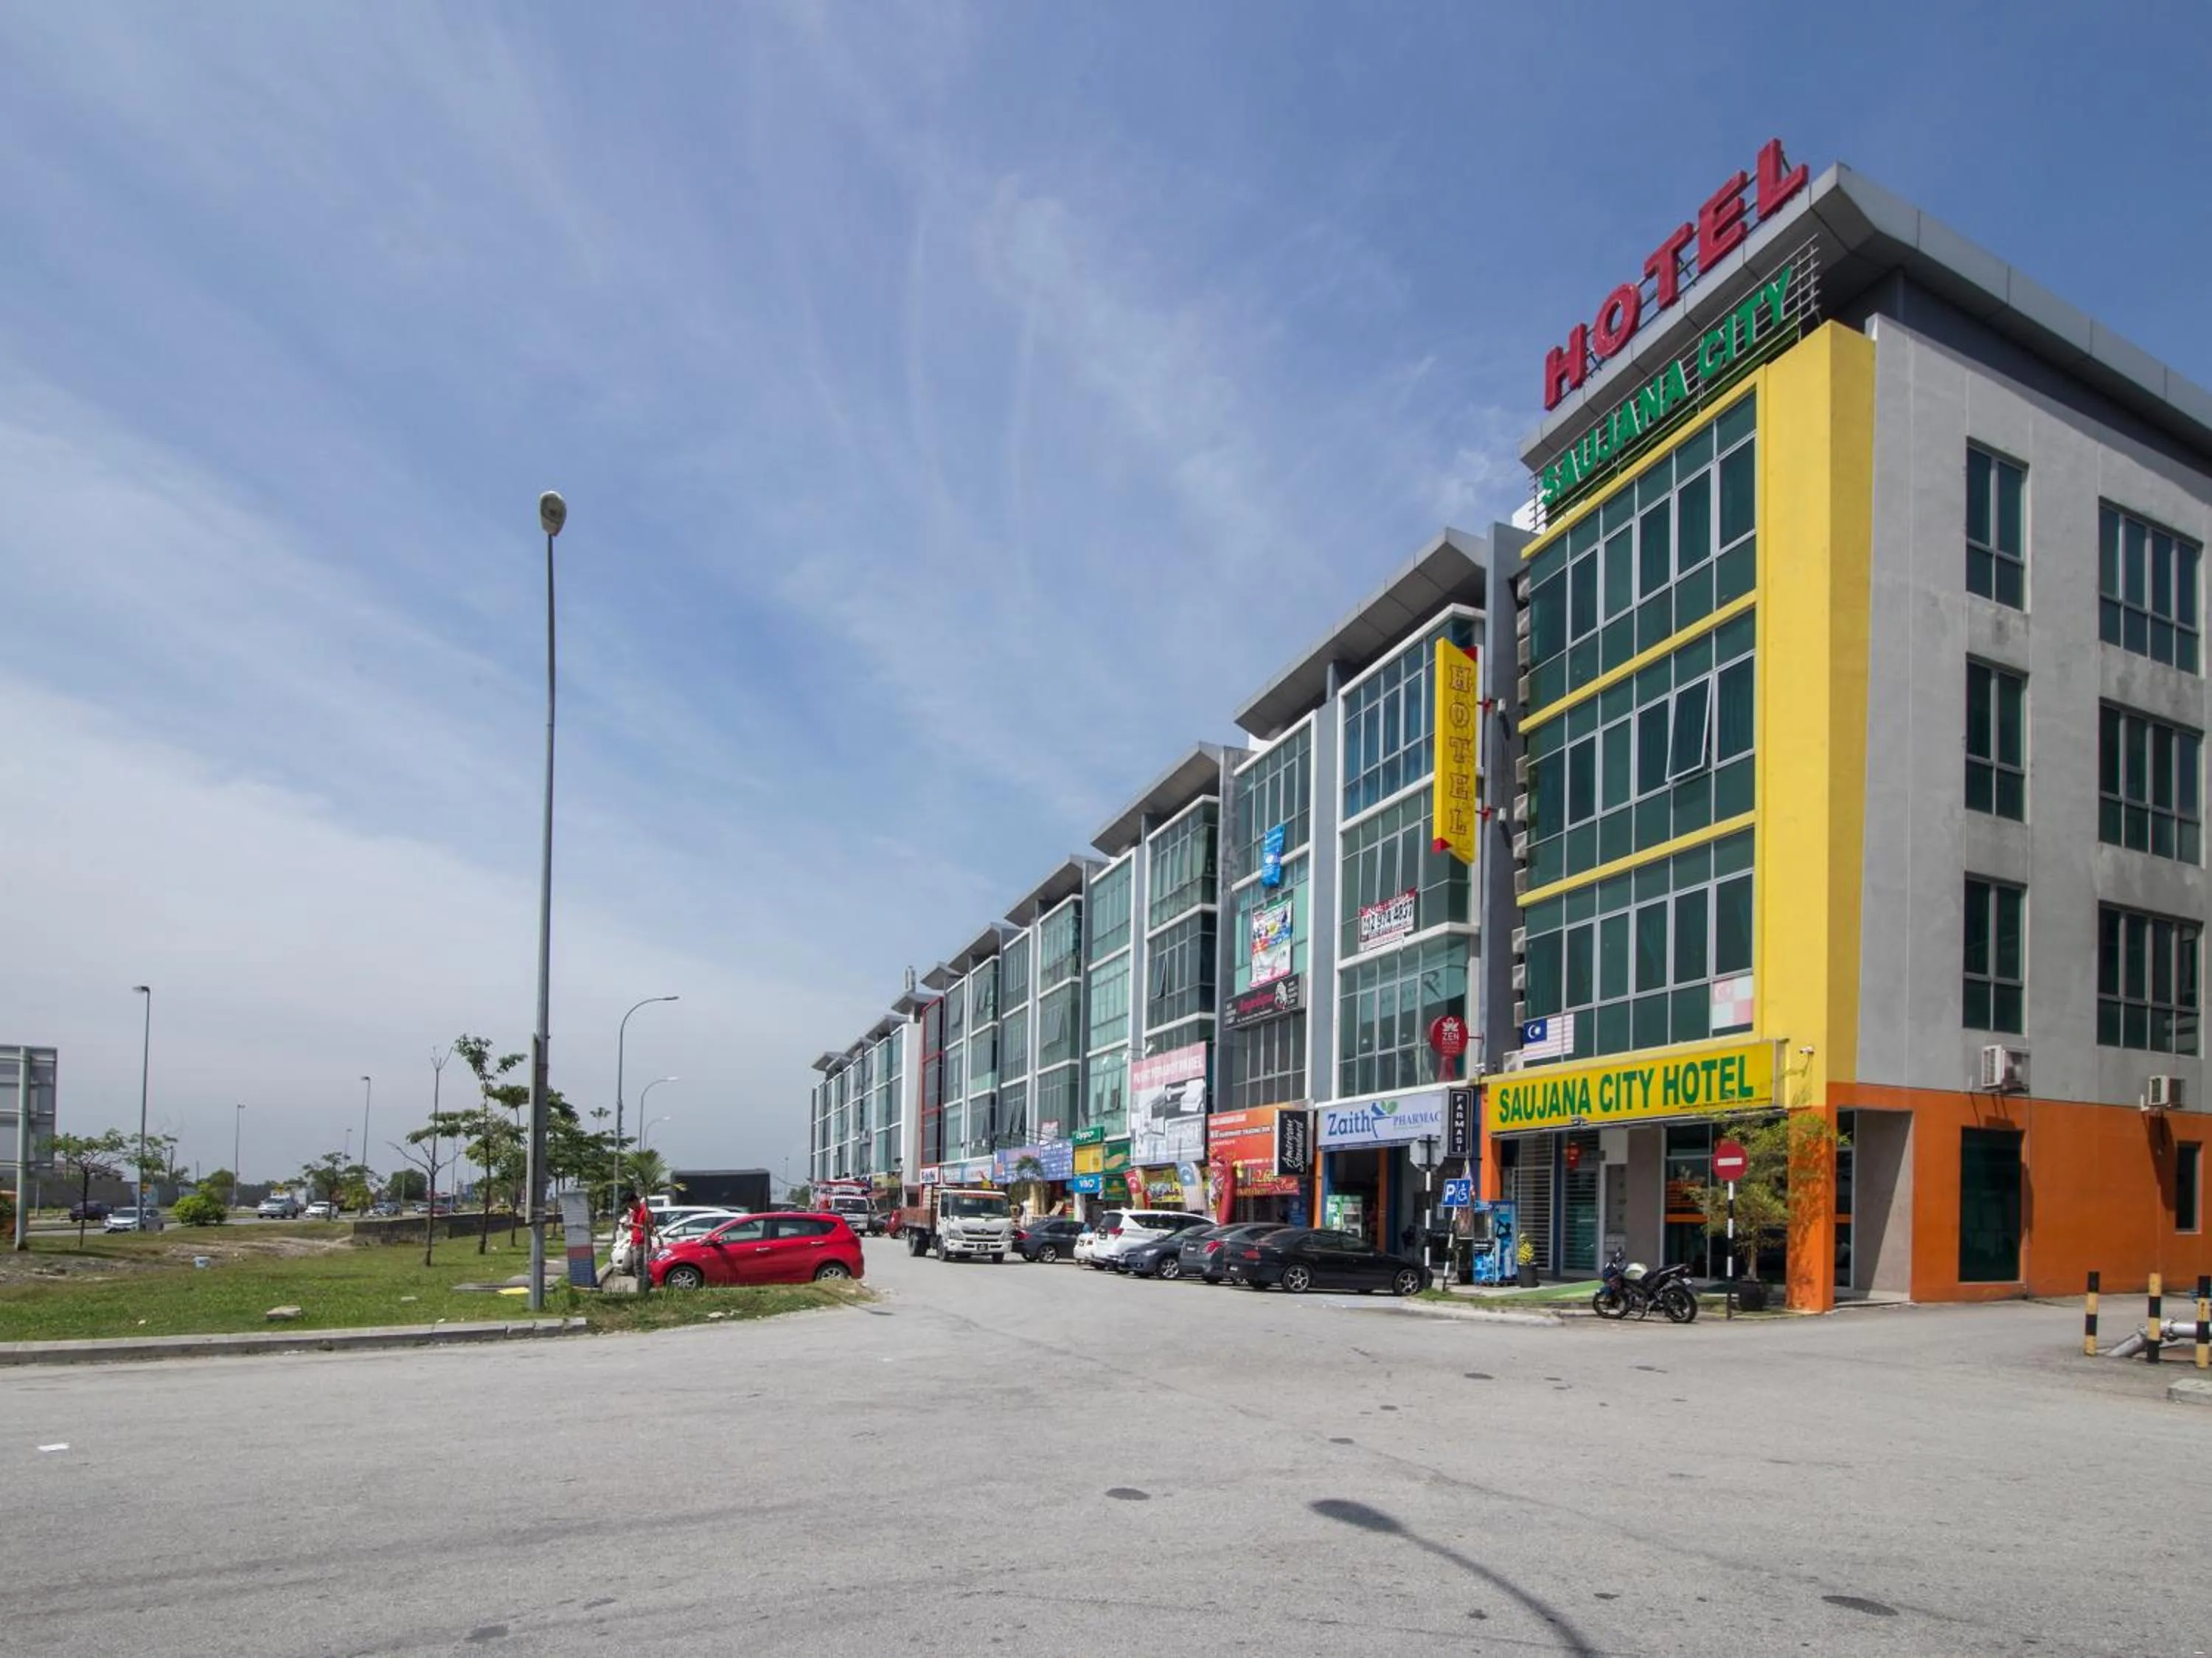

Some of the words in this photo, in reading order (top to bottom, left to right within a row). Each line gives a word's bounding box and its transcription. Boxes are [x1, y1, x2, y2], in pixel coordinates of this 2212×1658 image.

[1544, 138, 1809, 411] HOTEL
[1542, 359, 1689, 507] SAUJANA
[1698, 265, 1792, 379] CITY
[1449, 664, 1471, 836] HOTEL
[1442, 1032, 1459, 1041] ZEN
[1499, 1078, 1592, 1123] SAUJANA
[1599, 1067, 1655, 1113] CITY
[1663, 1055, 1754, 1106] HOTEL
[1327, 1109, 1371, 1136] Zaith
[1454, 1095, 1464, 1152] FARMASI
[1445, 1184, 1456, 1202] P
